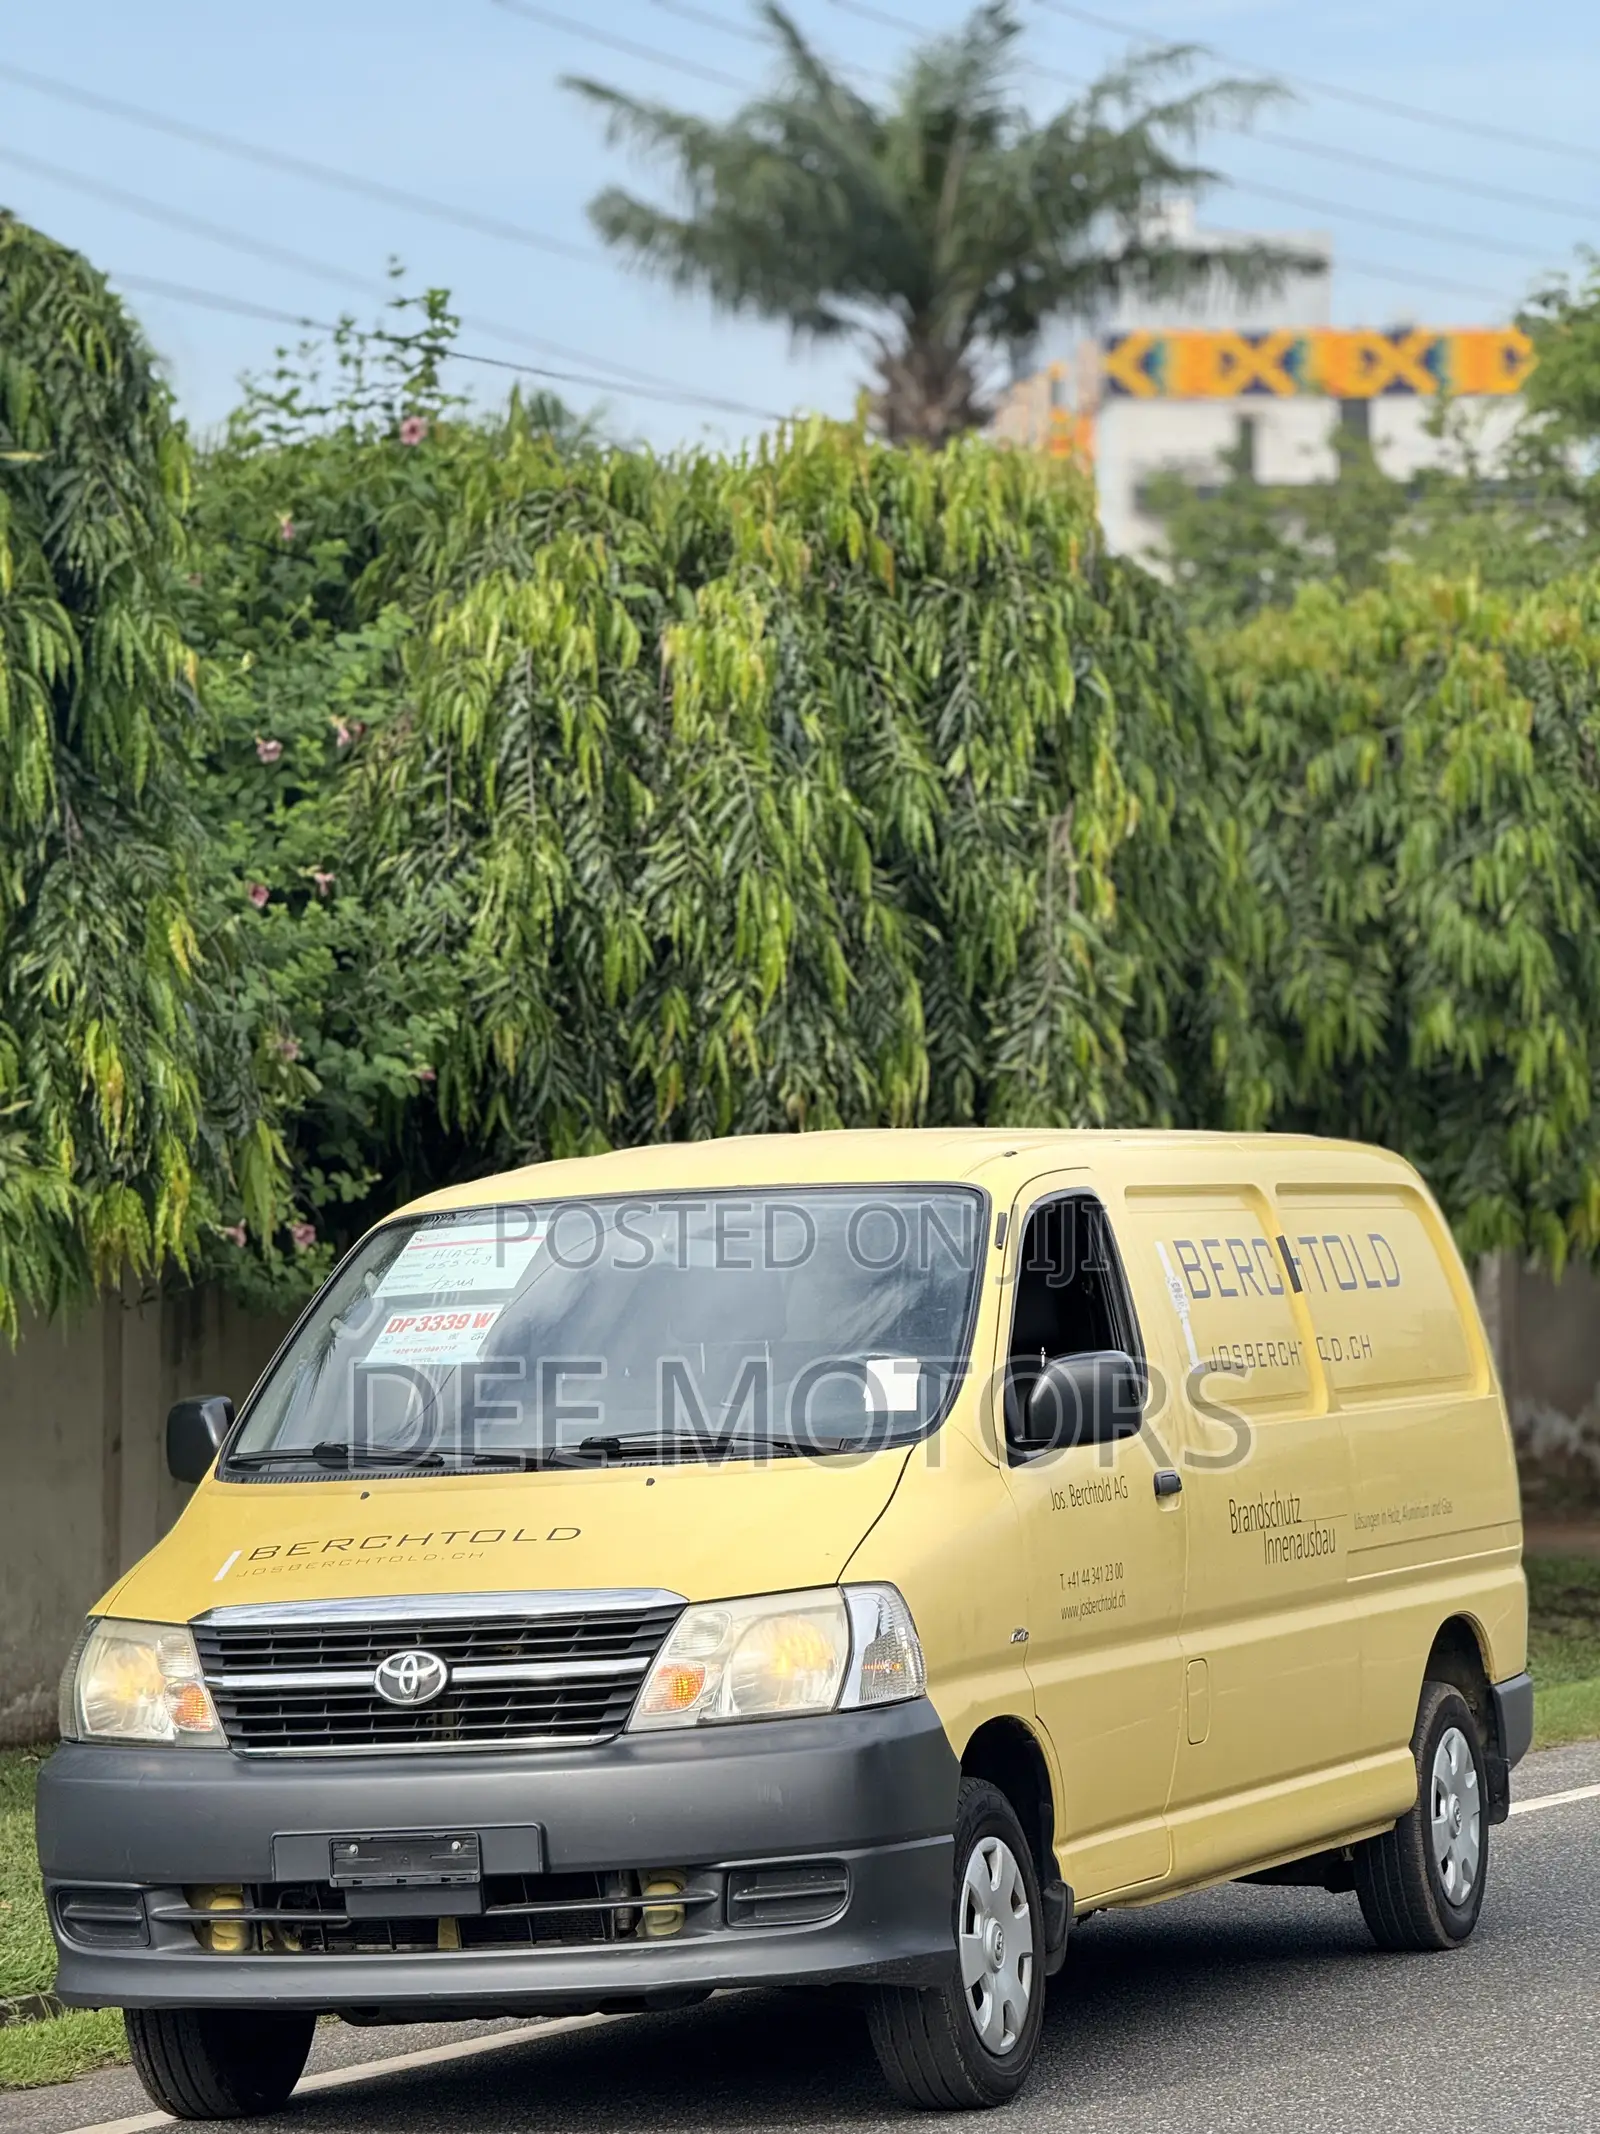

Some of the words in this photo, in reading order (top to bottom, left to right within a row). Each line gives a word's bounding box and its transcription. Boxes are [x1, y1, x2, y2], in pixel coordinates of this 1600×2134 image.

[385, 1317, 417, 1334] DP
[415, 1313, 472, 1332] 3339
[471, 1312, 495, 1329] W
[1050, 1488, 1069, 1511] Jos.
[1068, 1476, 1112, 1507] Berchtold
[1113, 1475, 1129, 1500] AG
[1229, 1490, 1302, 1534] Brandschutz
[247, 1527, 583, 1562] BERCHTOLD
[1263, 1520, 1336, 1565] Innenausbau
[235, 1551, 485, 1578] JOSBERCHTOLD.CH
[1067, 1570, 1080, 1590] +41
[1081, 1568, 1091, 1586] 44
[1091, 1565, 1104, 1585] 341
[1105, 1563, 1114, 1582] 23
[1115, 1561, 1124, 1580] 00
[1060, 1589, 1127, 1622] www.josberchtold.ch
